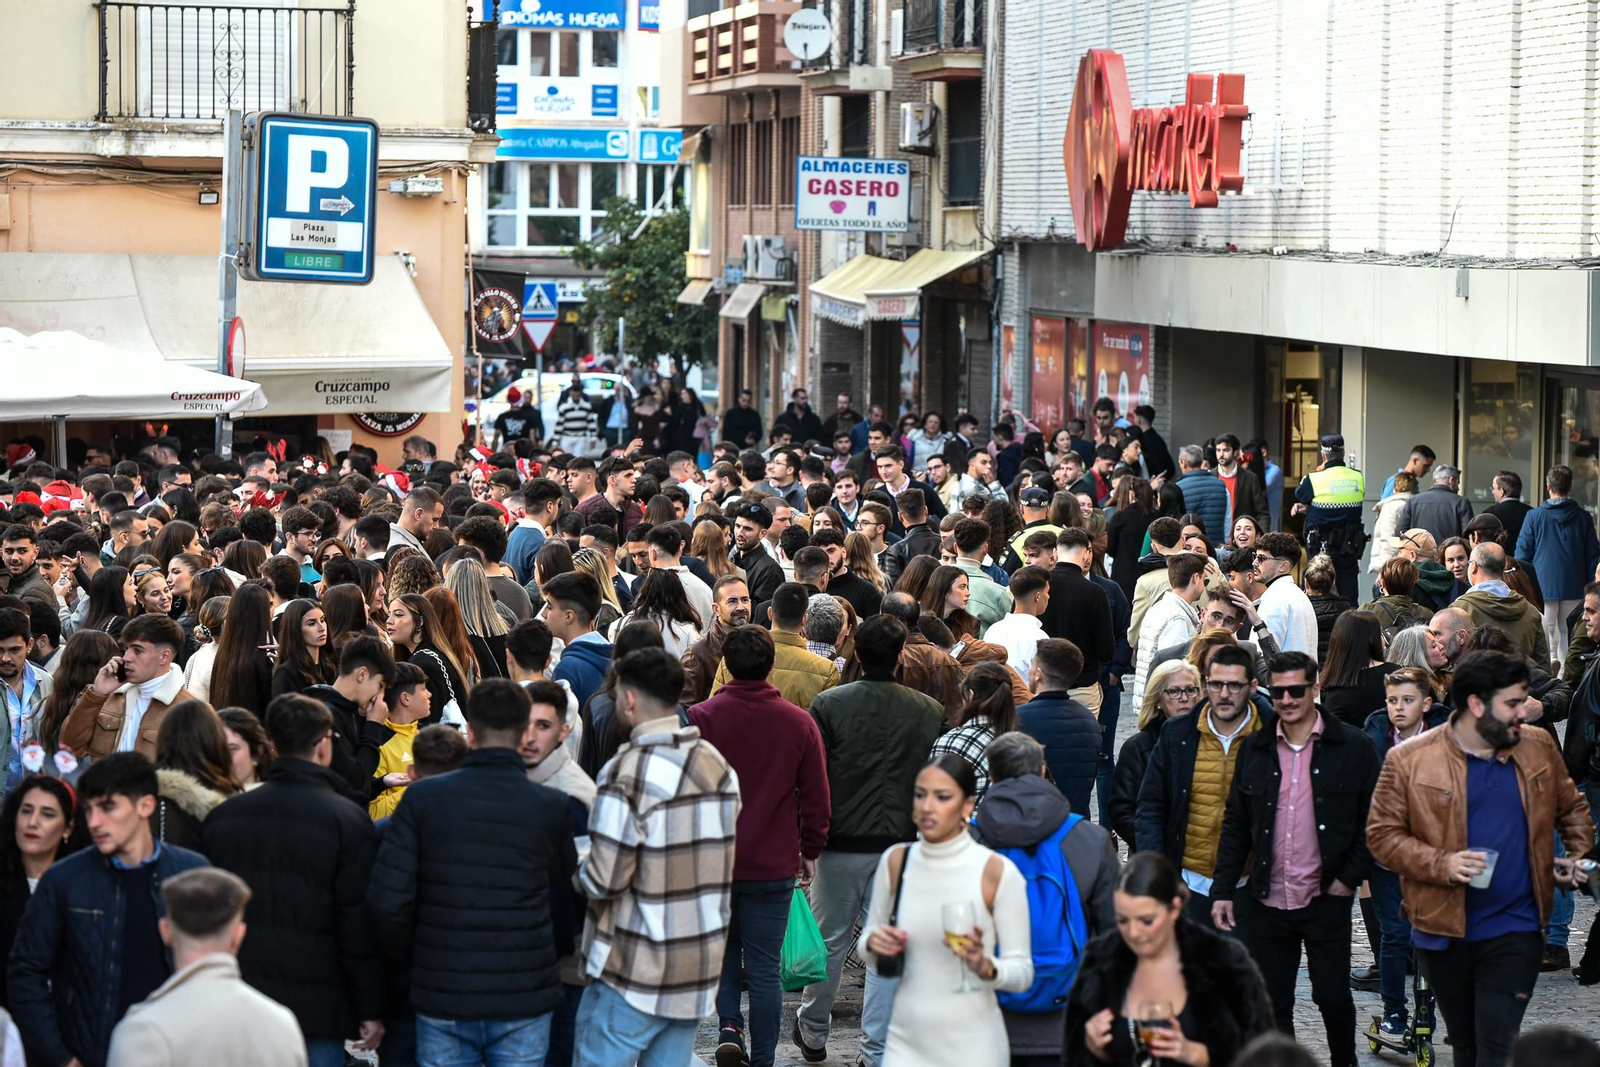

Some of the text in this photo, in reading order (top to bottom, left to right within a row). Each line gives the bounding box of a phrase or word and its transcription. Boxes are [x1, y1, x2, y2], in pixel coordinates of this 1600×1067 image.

[569, 12, 620, 27] HUELVA
[286, 134, 349, 213] P
[801, 160, 908, 175] ALMACENES
[807, 178, 900, 198] CASERO
[303, 222, 325, 232] Plaza
[798, 218, 908, 229] OFERTAS TODO EL AÑO
[291, 234, 337, 244] Las Monjas
[294, 255, 333, 268] LIBRE
[315, 380, 390, 394] Cruzcampo
[170, 391, 241, 403] Cruzcampo
[325, 394, 378, 405] ESPECIAL
[183, 402, 225, 412] ESPECIAL
